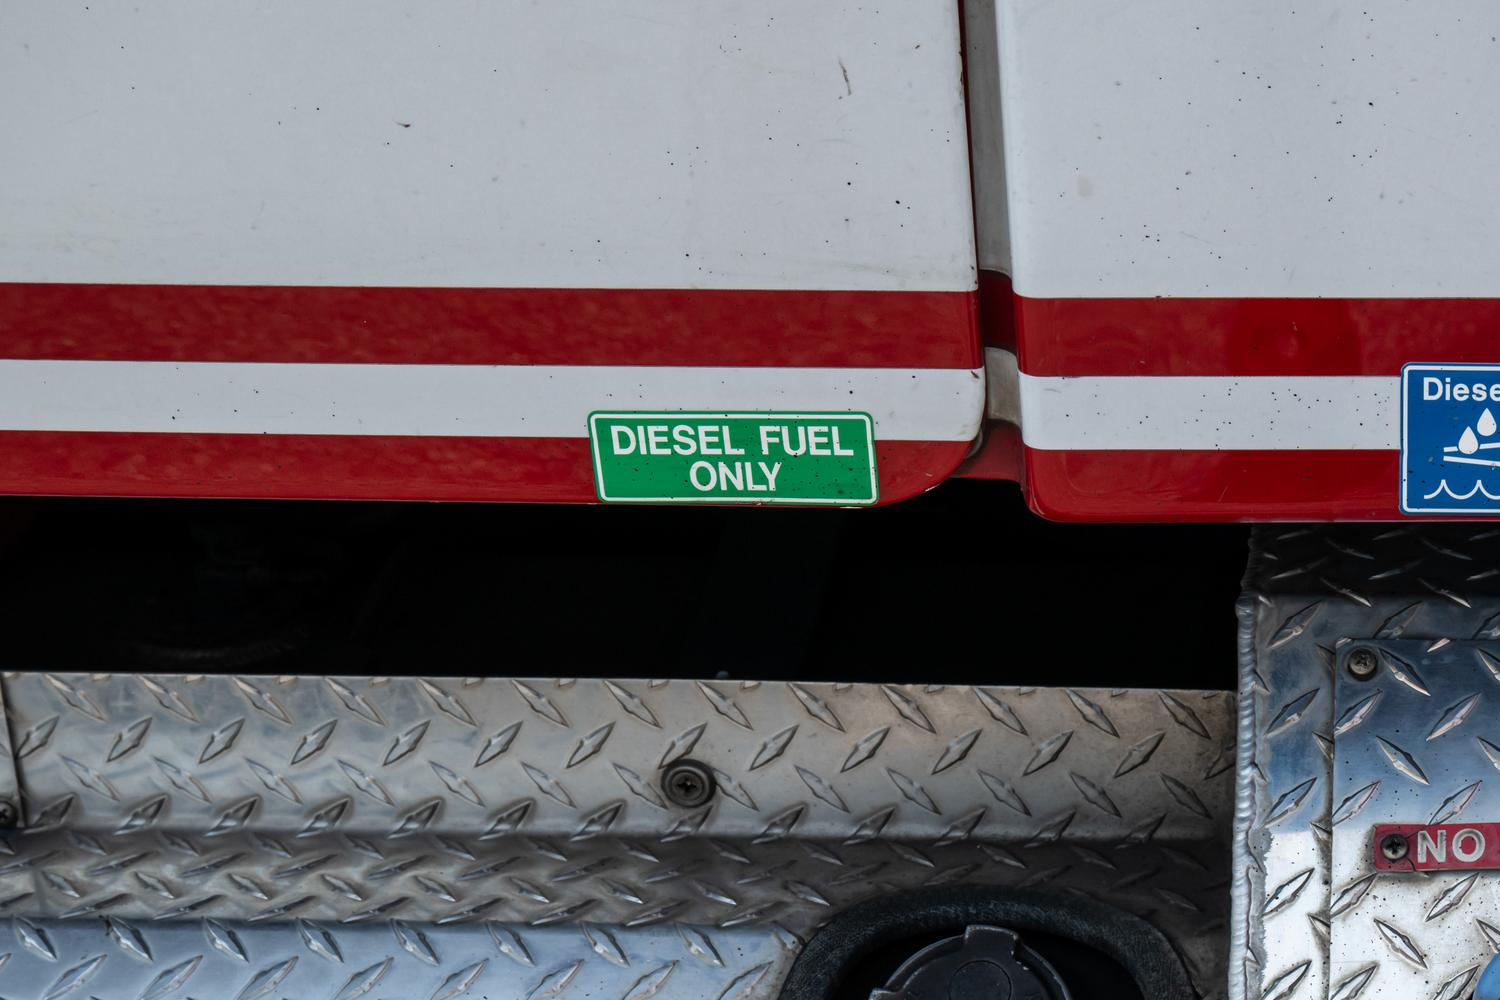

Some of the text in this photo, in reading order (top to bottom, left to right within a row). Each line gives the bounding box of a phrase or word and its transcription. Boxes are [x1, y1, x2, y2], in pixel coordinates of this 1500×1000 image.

[610, 424, 854, 456] DIESEL FUEL
[689, 460, 783, 491] ONLY
[1417, 827, 1486, 864] NO
